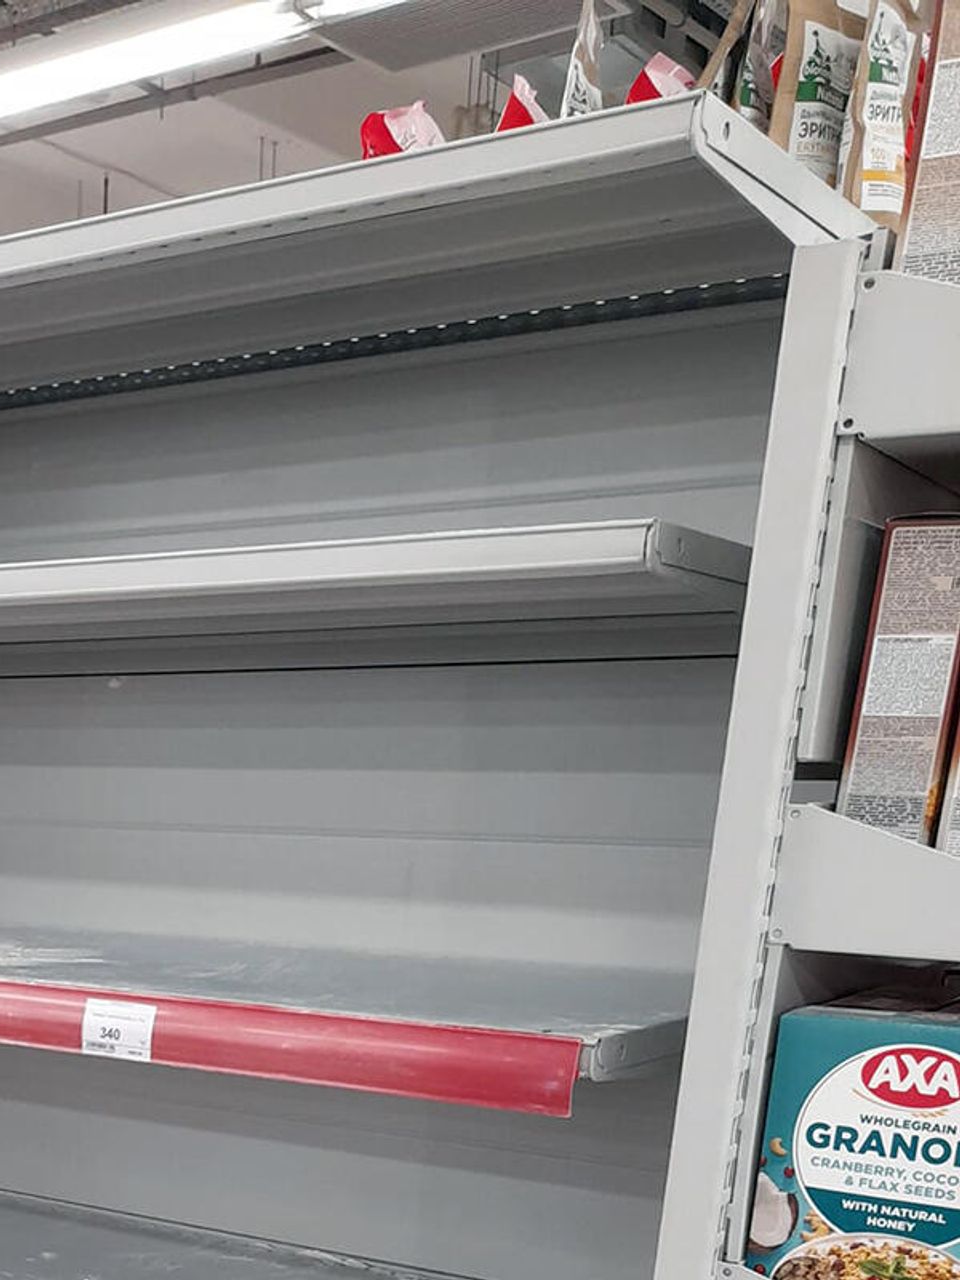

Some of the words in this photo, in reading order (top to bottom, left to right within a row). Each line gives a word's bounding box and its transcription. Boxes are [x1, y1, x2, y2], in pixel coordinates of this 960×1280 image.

[99, 1026, 121, 1041] 340
[868, 1054, 960, 1098] AXA
[859, 1114, 957, 1134] WHOLEGRAIN
[810, 1156, 907, 1181] CRANBERRY,
[912, 1170, 960, 1187] COCO
[844, 1176, 854, 1186] &
[858, 1177, 899, 1193] FLAX
[903, 1184, 956, 1201] SEEDS
[841, 1199, 877, 1214] WITH
[880, 1205, 947, 1225] NATURAL
[866, 1216, 916, 1232] HONEY
